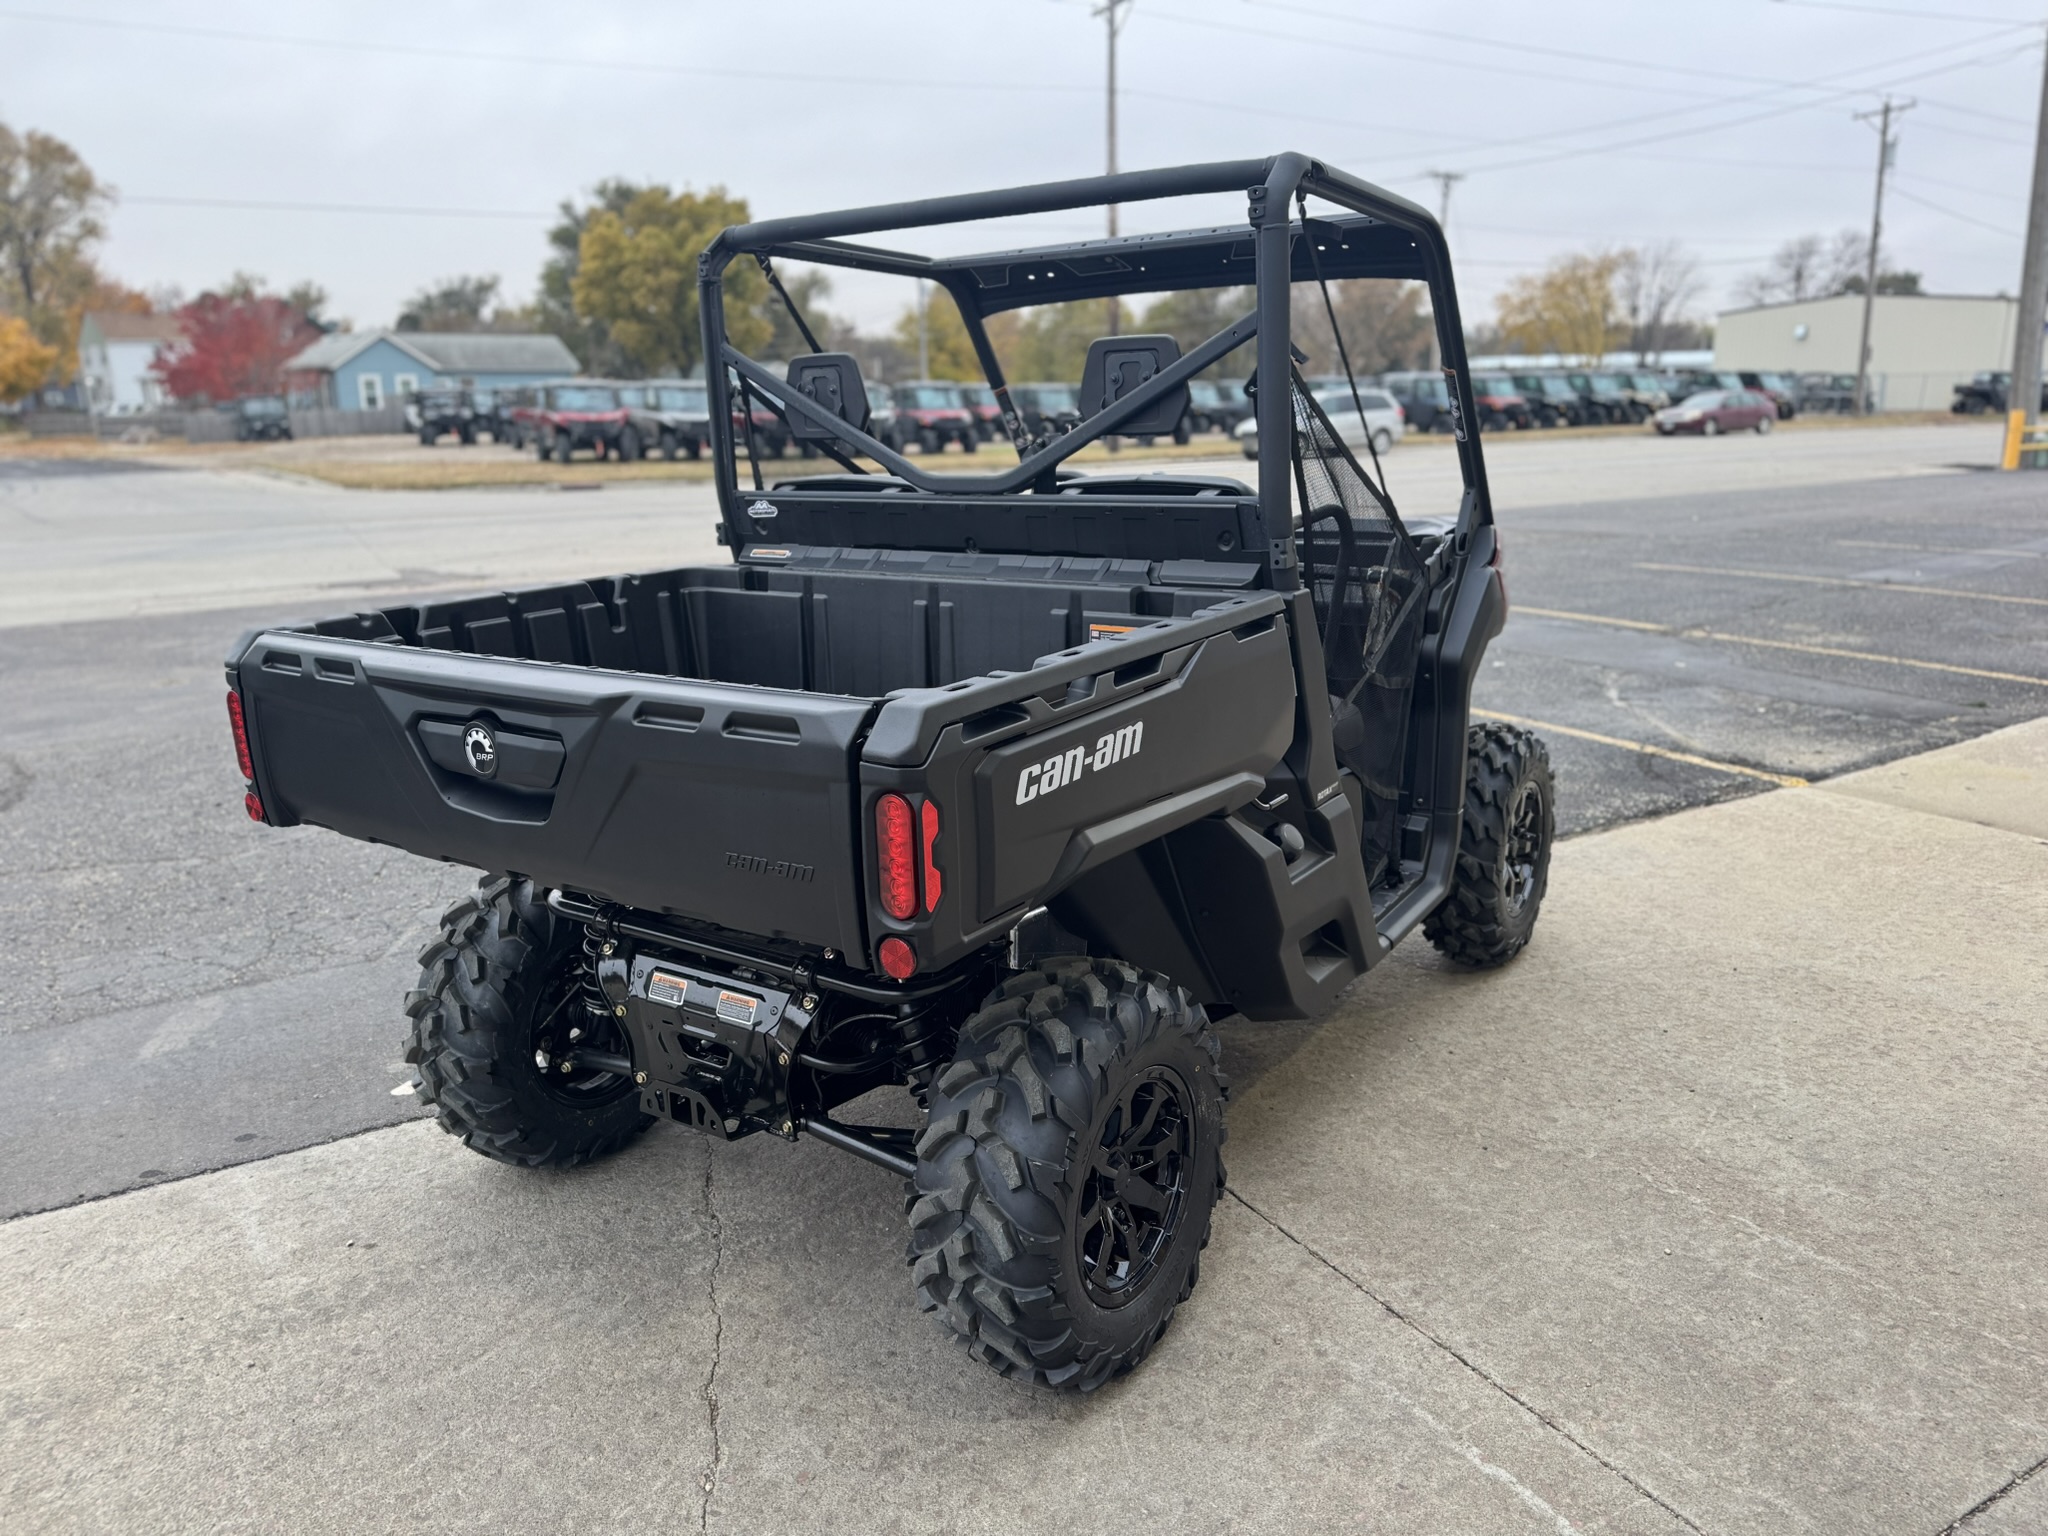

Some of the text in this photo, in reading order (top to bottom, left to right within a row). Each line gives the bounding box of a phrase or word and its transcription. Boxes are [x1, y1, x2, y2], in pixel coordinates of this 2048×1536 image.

[476, 752, 494, 761] BRP
[1016, 721, 1143, 805] can-am
[725, 851, 815, 883] can-am
